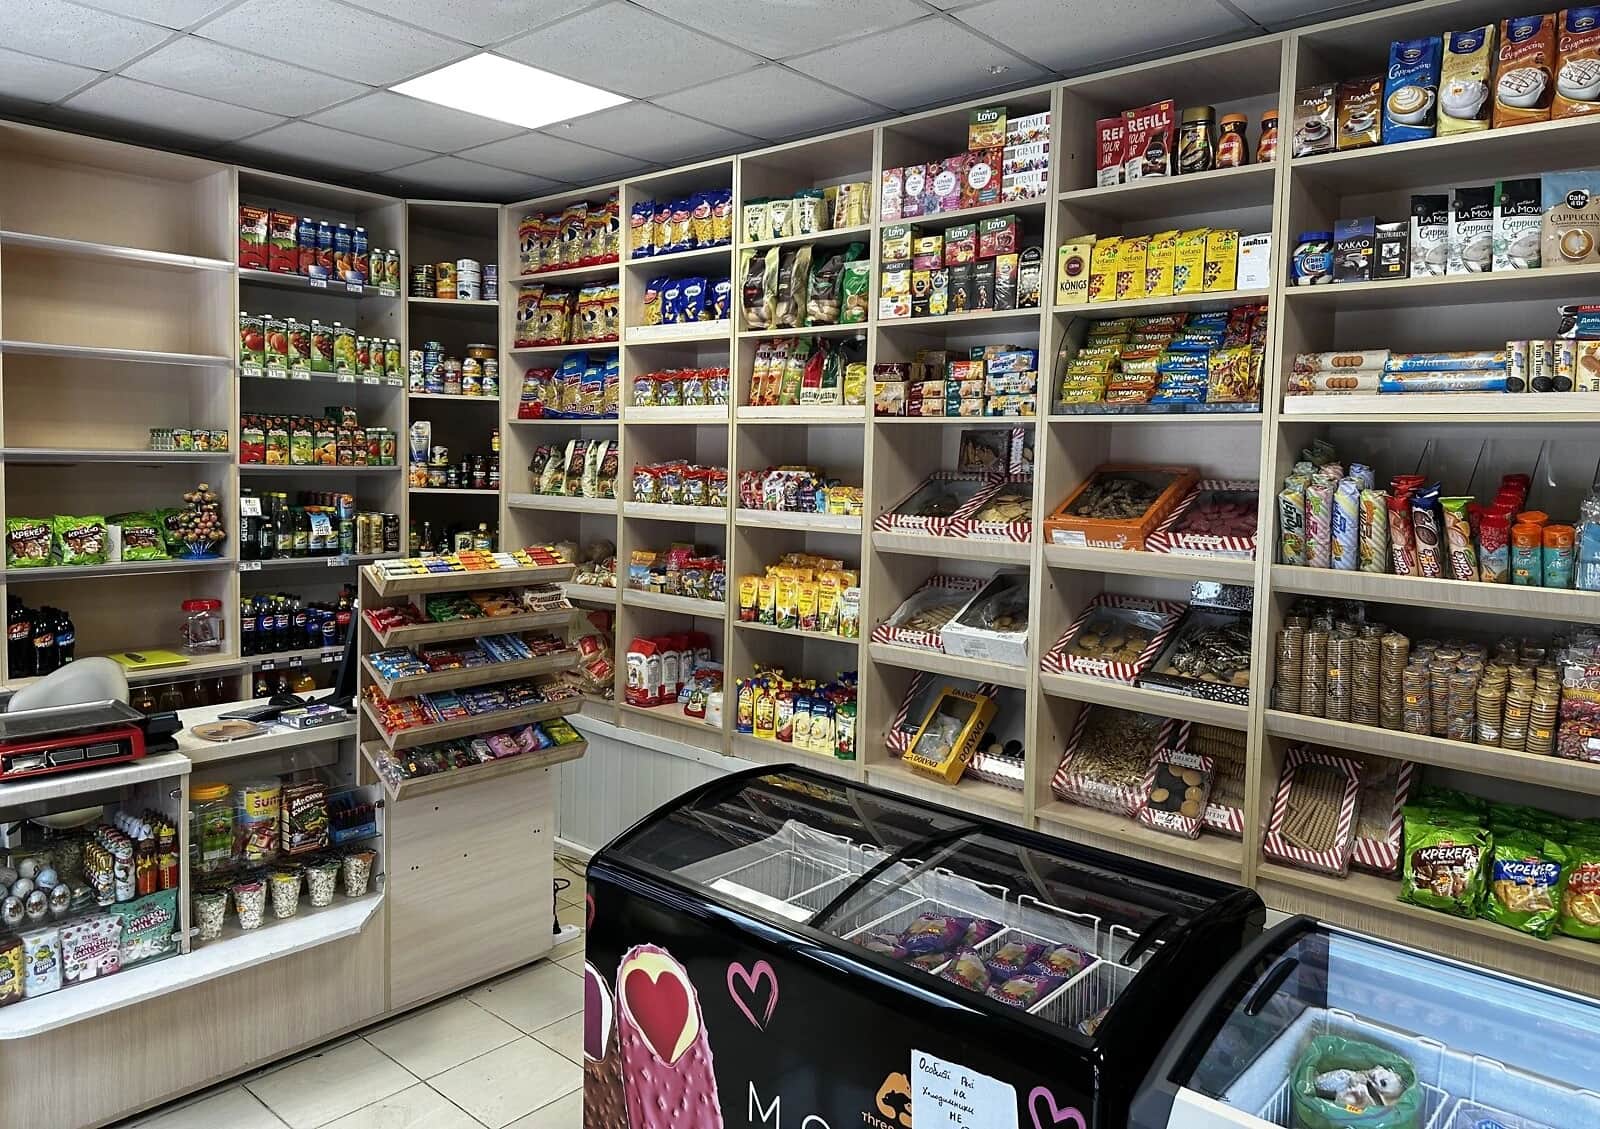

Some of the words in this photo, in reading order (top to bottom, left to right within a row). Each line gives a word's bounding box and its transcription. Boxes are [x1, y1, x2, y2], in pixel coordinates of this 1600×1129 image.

[1128, 112, 1171, 133] REFILL
[1504, 207, 1516, 215] LA
[1458, 212, 1470, 220] LA
[1337, 240, 1370, 250] KAKAO
[1060, 279, 1087, 291] KÖNIGS
[1100, 320, 1125, 328] Wafers
[1148, 316, 1173, 326] Wafers
[1145, 332, 1173, 341] Wafers
[1184, 333, 1211, 342] Wafers
[1136, 343, 1162, 351] Wafers
[1076, 359, 1101, 368] Wafers
[1171, 355, 1200, 364] Wafers
[1074, 374, 1098, 382] Wafers
[1125, 374, 1151, 382] Wafers
[1172, 374, 1200, 382] Wafers
[1069, 389, 1094, 397] Wafers
[1118, 389, 1145, 397] Wafers
[1421, 848, 1473, 860] КРЕКЕР
[1503, 862, 1554, 876] КРЕКЕР
[950, 1111, 962, 1124] НЕ
